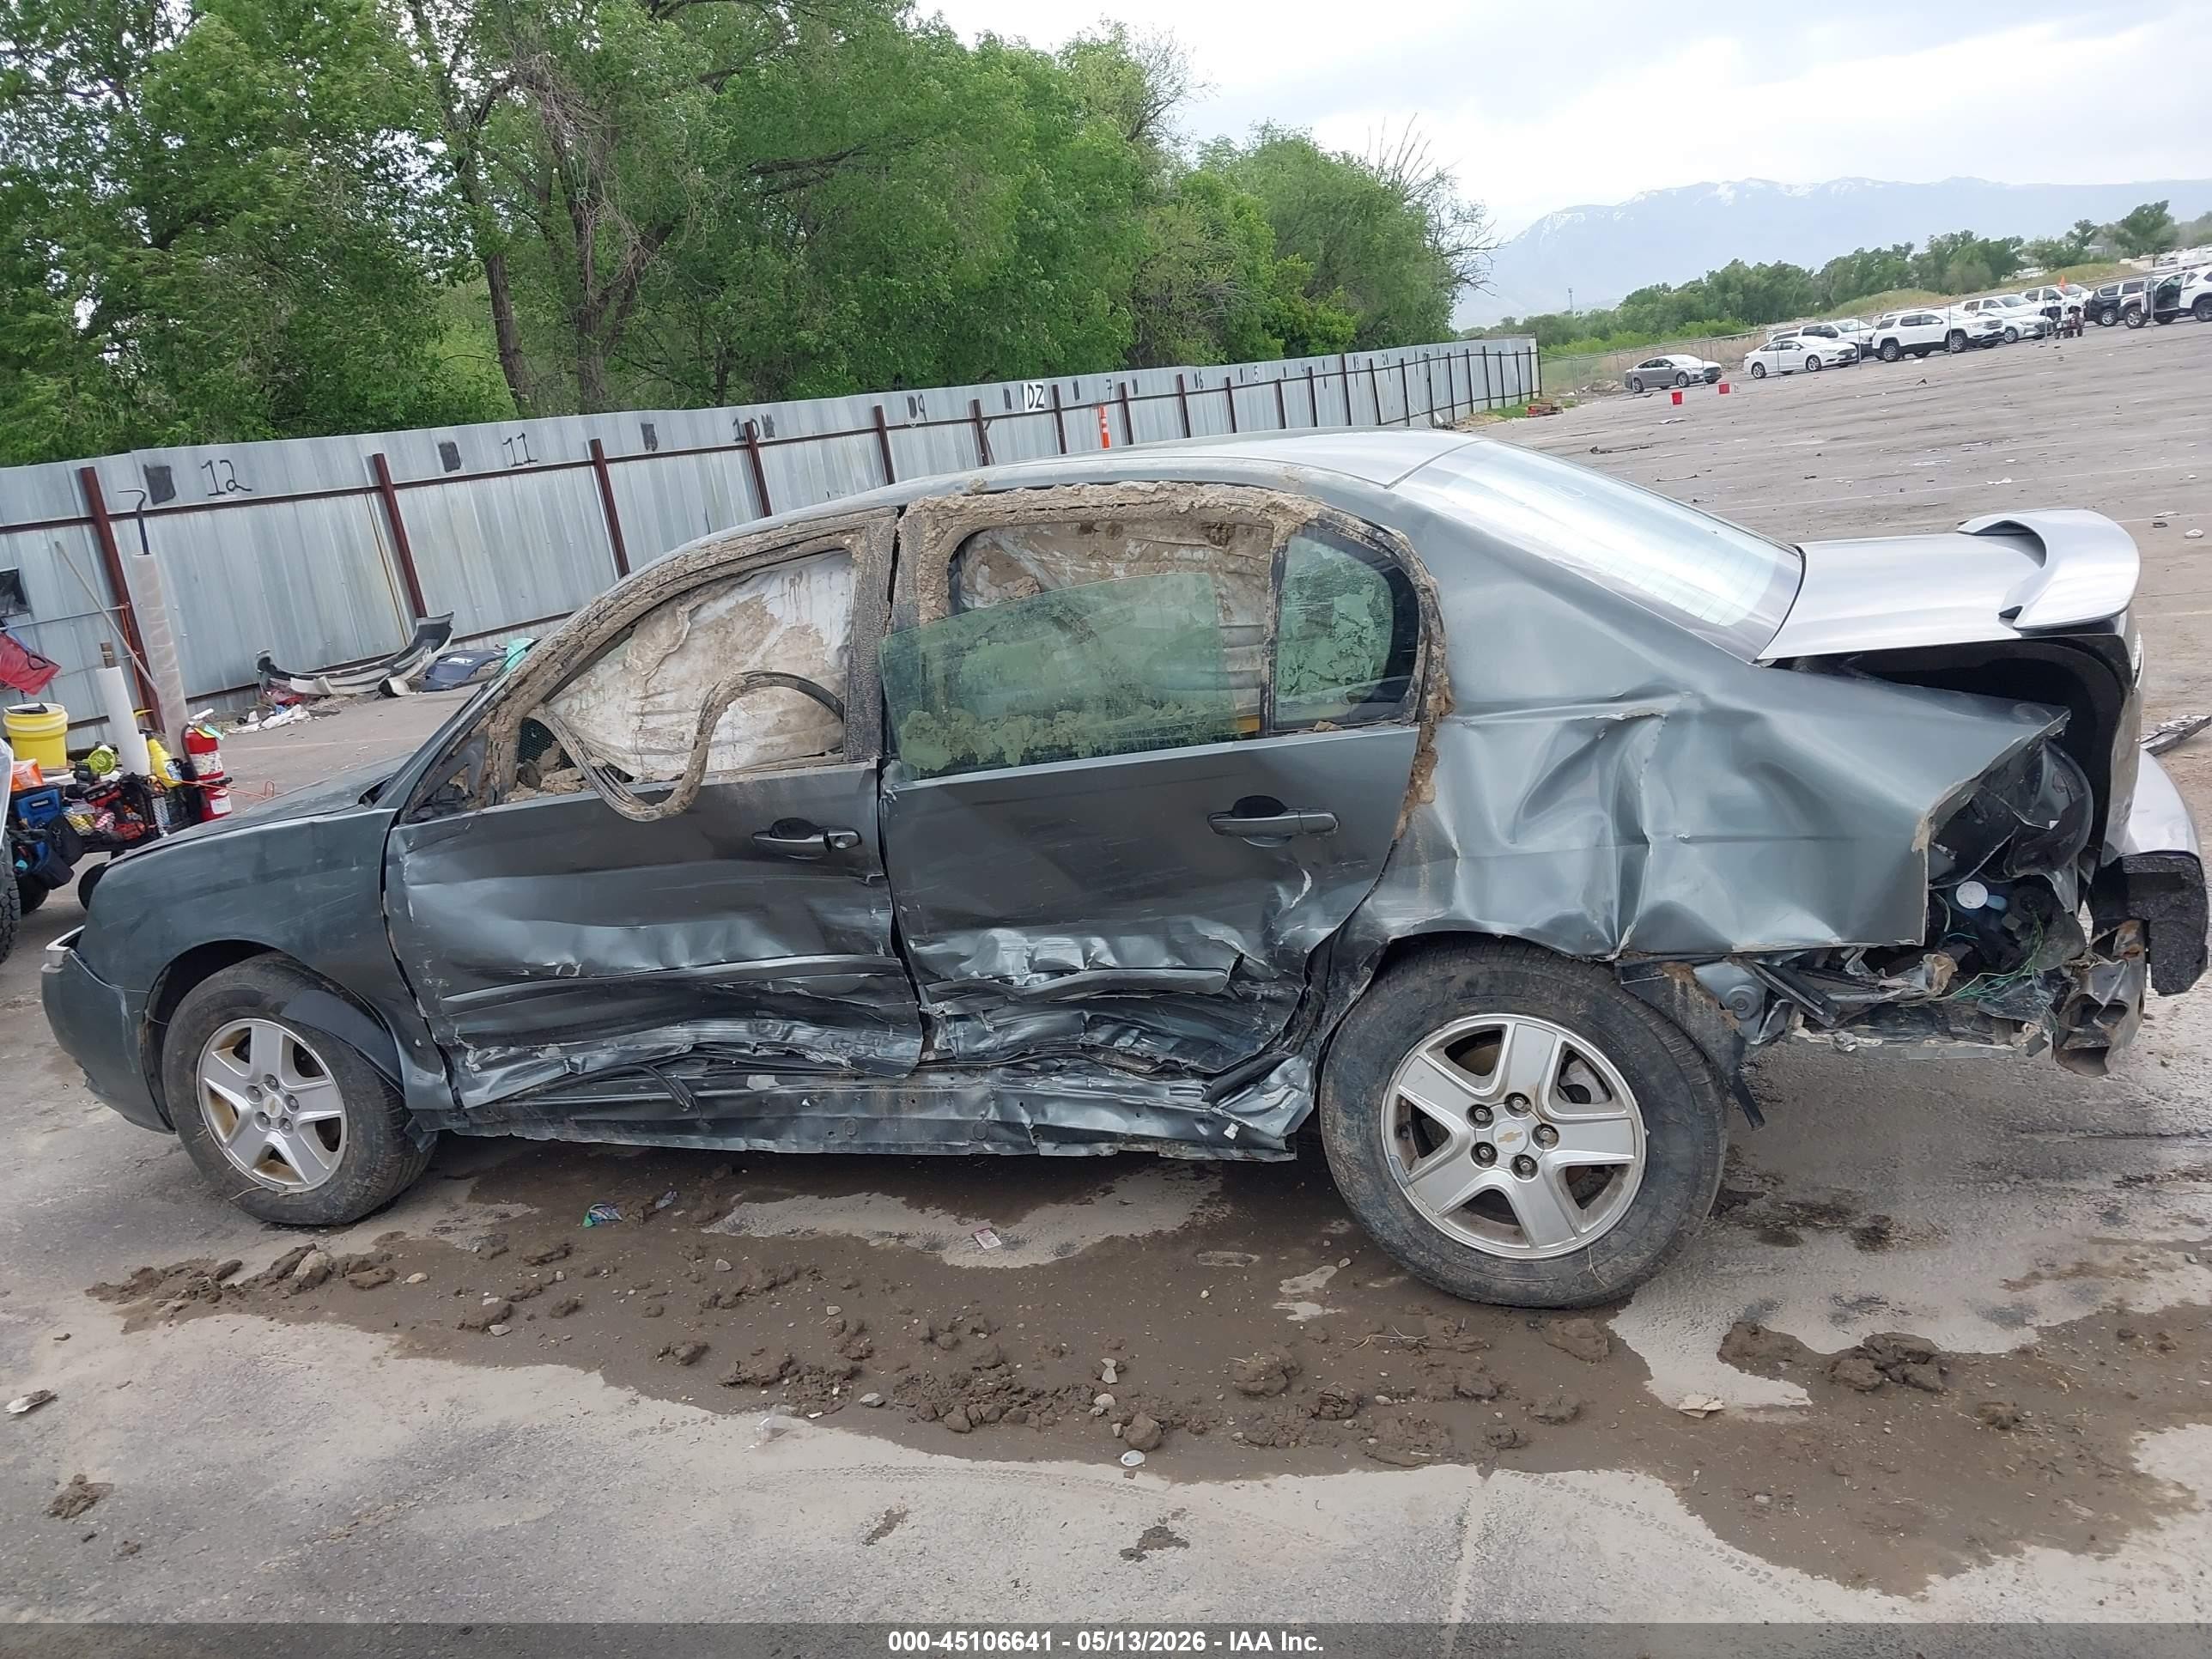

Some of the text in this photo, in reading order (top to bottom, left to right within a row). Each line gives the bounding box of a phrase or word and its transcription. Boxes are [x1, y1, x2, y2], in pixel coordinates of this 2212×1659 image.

[1106, 379, 1114, 401] 7
[502, 433, 538, 467] 11
[201, 459, 252, 496] 12
